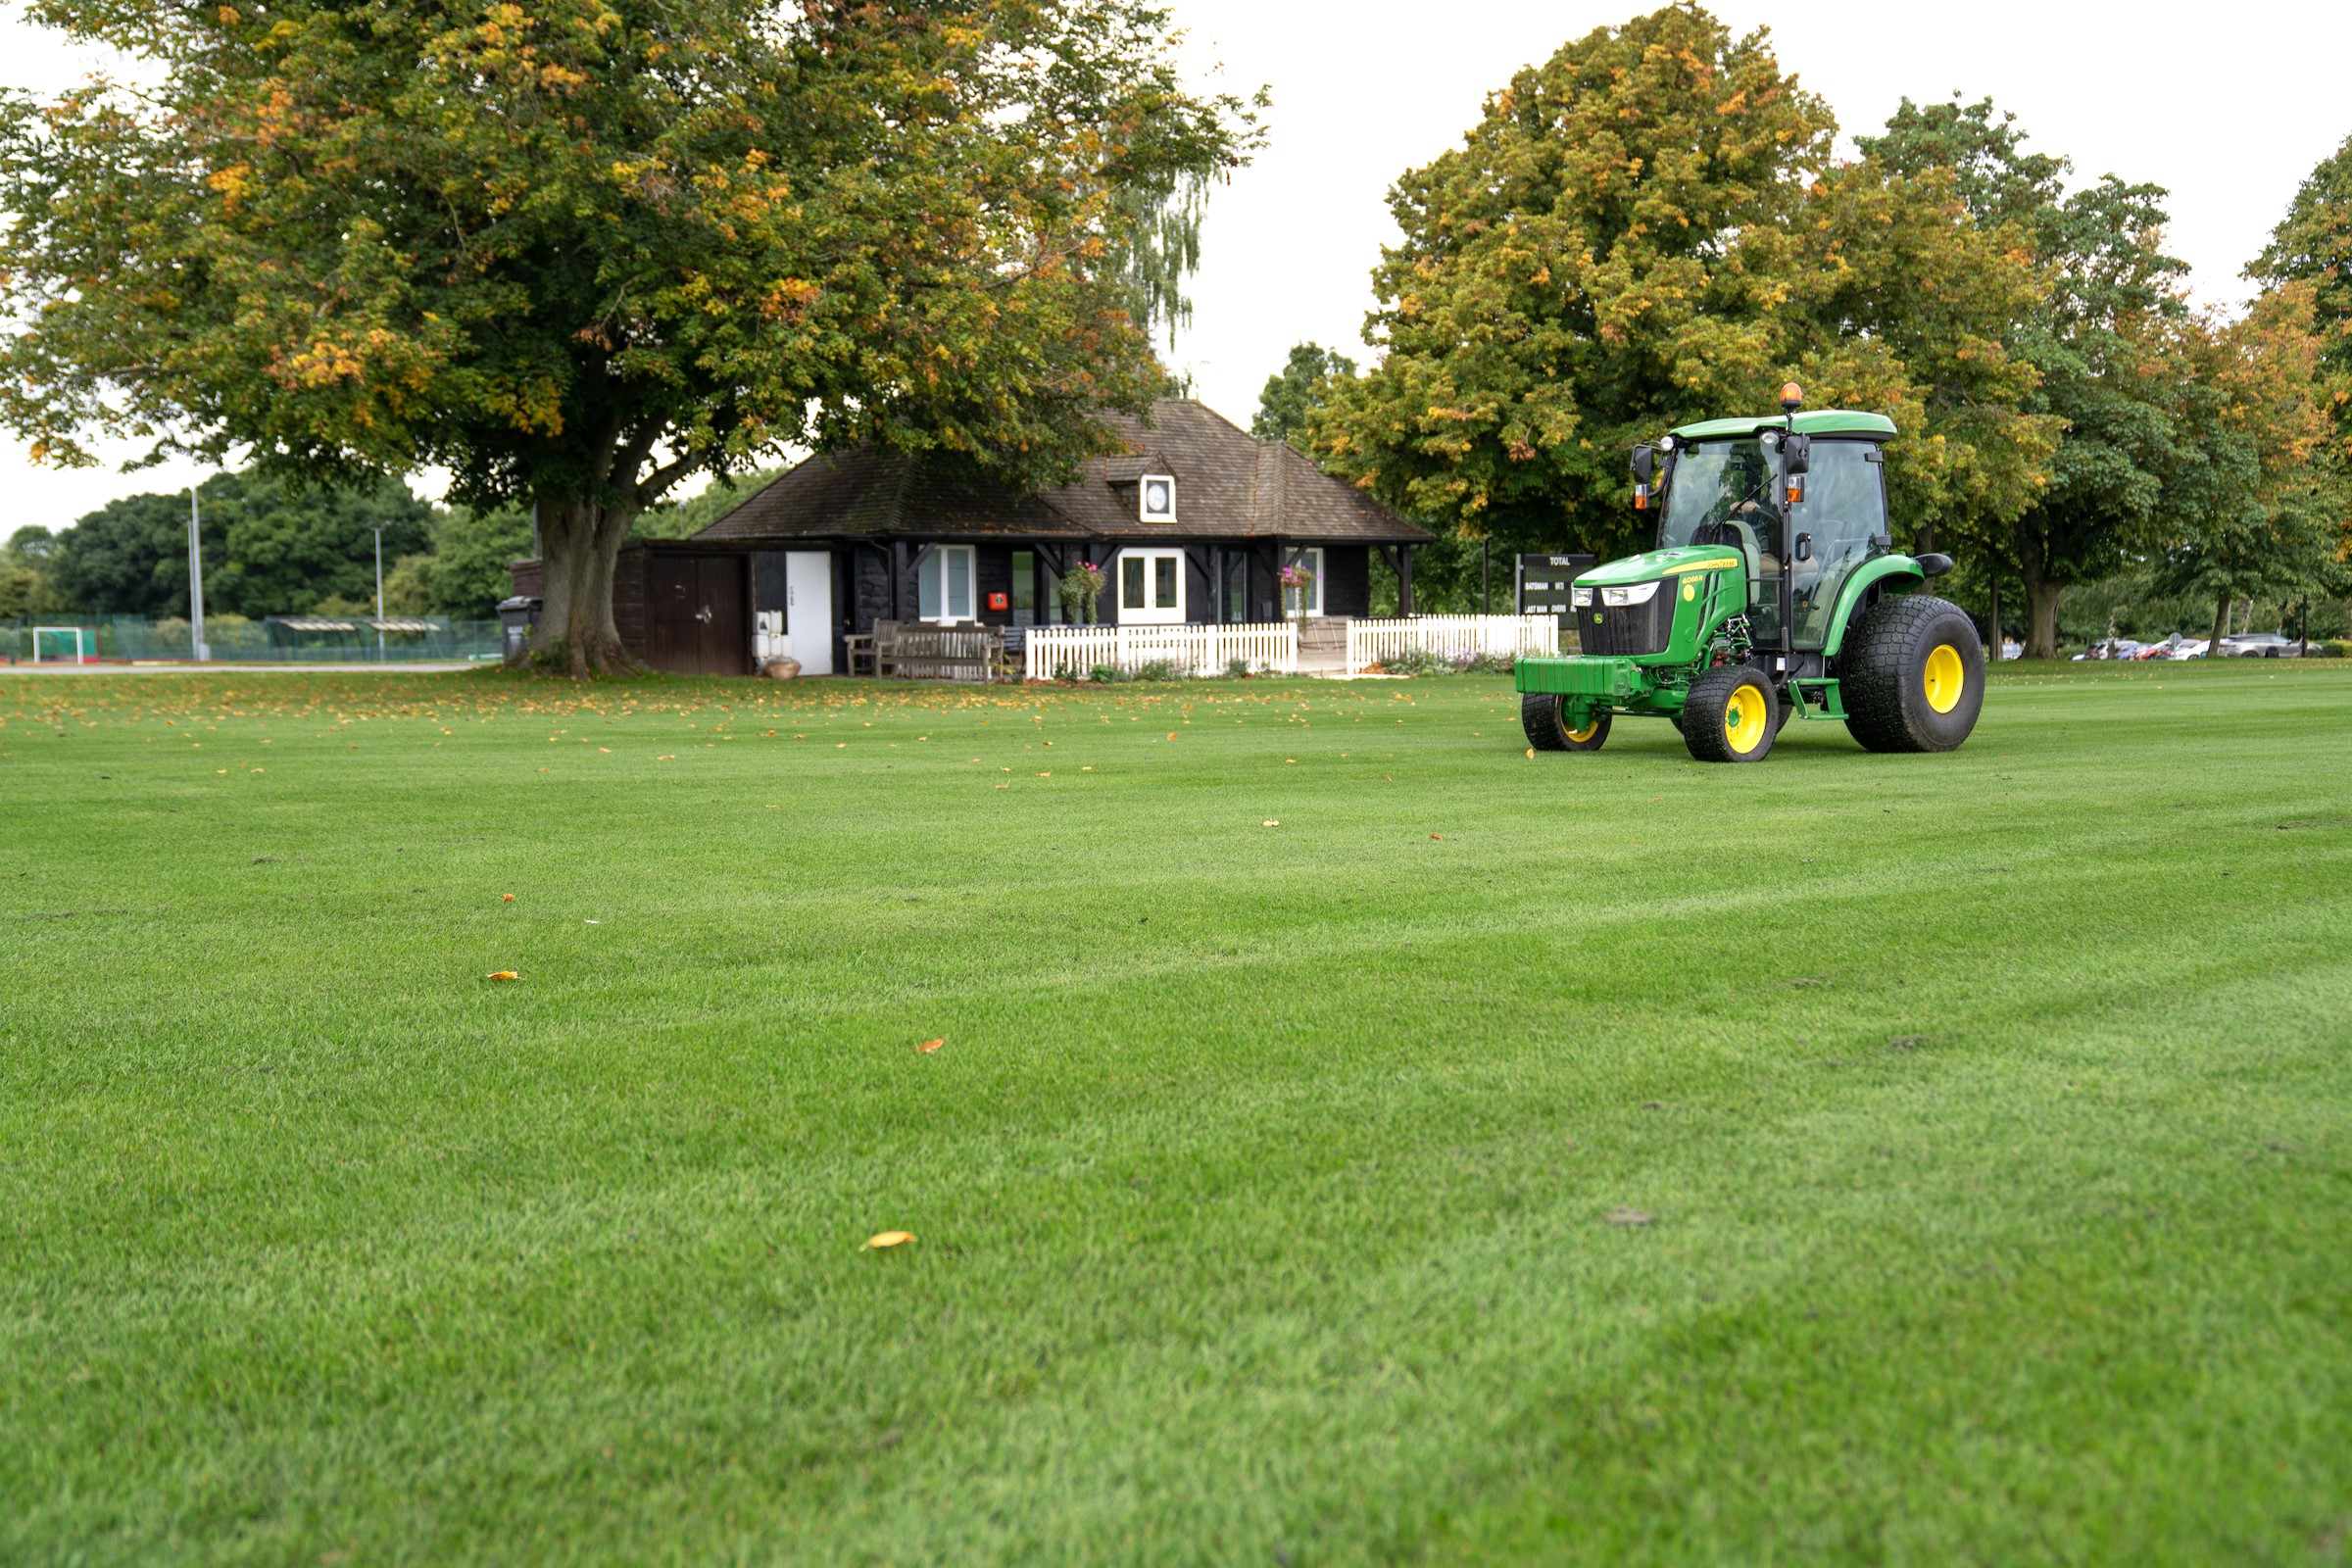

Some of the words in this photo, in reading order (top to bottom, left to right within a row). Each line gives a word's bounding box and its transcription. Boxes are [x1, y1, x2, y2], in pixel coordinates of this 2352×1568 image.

[1549, 557, 1570, 565] TOTAL
[1682, 574, 1703, 584] 4066R
[1525, 581, 1548, 590] BATSMAN
[1525, 605, 1536, 613] LAST
[1537, 605, 1547, 613] MAN
[1551, 604, 1567, 612] OVERS
